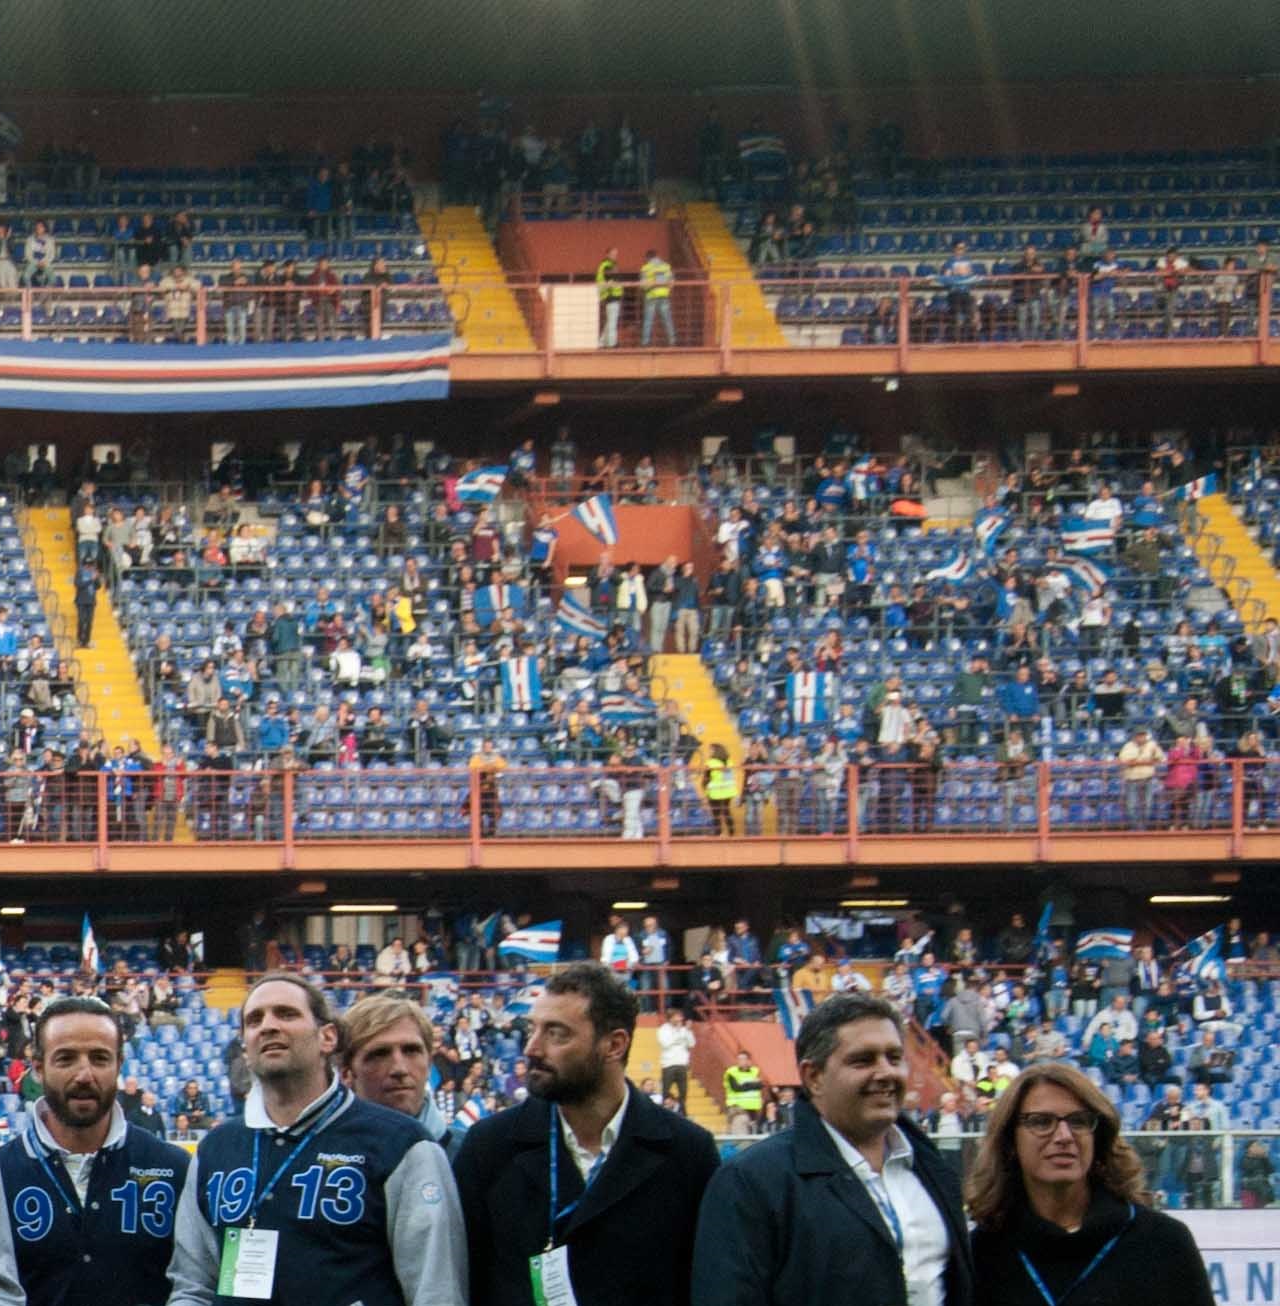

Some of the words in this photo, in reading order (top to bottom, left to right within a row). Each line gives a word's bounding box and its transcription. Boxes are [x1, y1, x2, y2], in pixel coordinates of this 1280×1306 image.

[111, 1180, 175, 1238] 13
[207, 1167, 256, 1227] 19
[292, 1165, 366, 1225] 13
